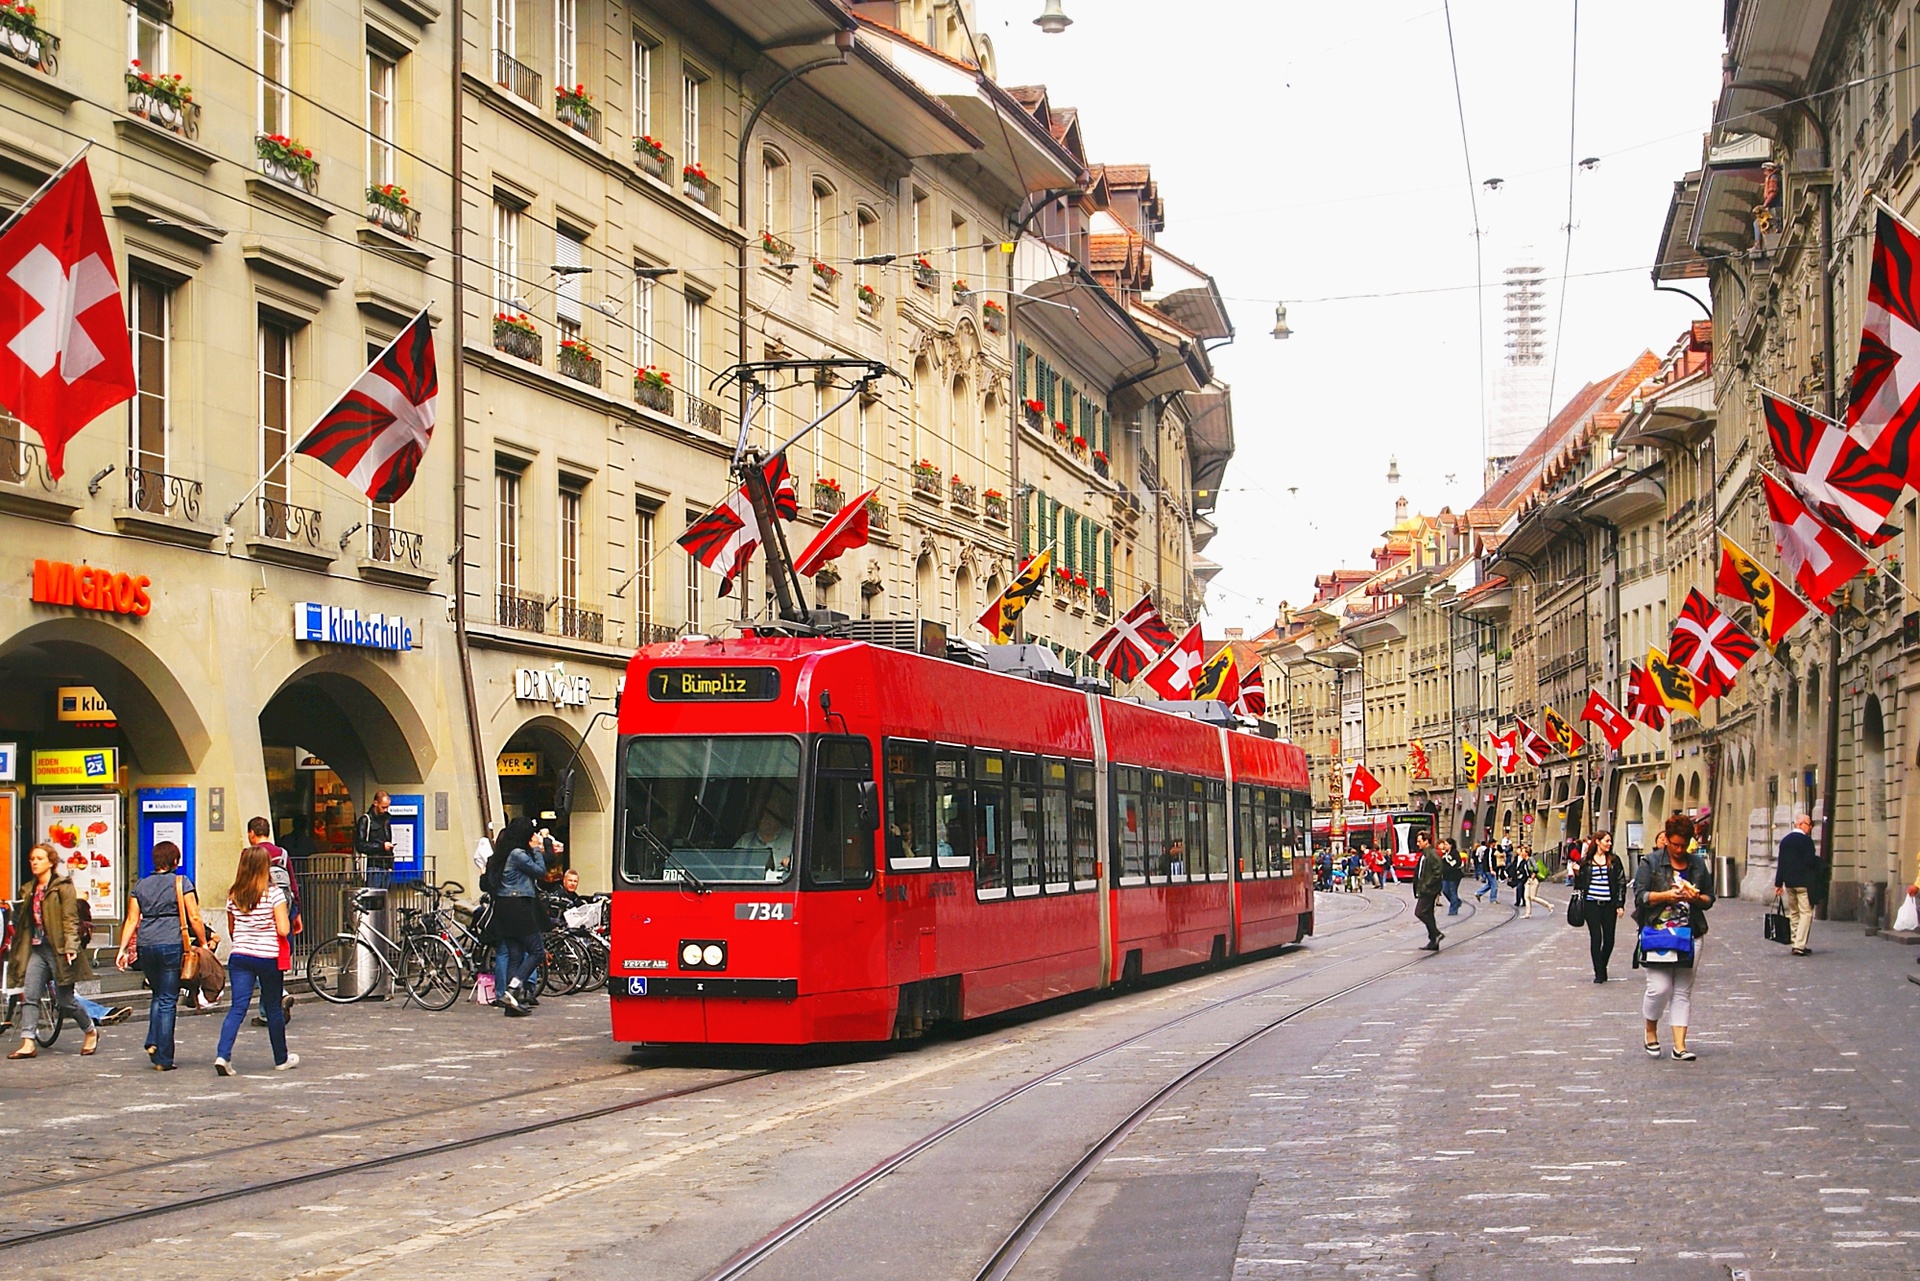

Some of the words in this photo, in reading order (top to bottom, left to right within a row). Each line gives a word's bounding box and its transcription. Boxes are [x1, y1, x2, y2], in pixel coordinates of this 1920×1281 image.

[33, 559, 151, 616] MIGROS
[329, 606, 412, 651] klubschule
[659, 675, 668, 693] 7
[682, 673, 746, 694] Bümpliz
[37, 767, 82, 775] DONNERSTAG
[497, 759, 520, 767] YER
[53, 805, 101, 813] MARKTFRISCH
[747, 903, 784, 921] 734
